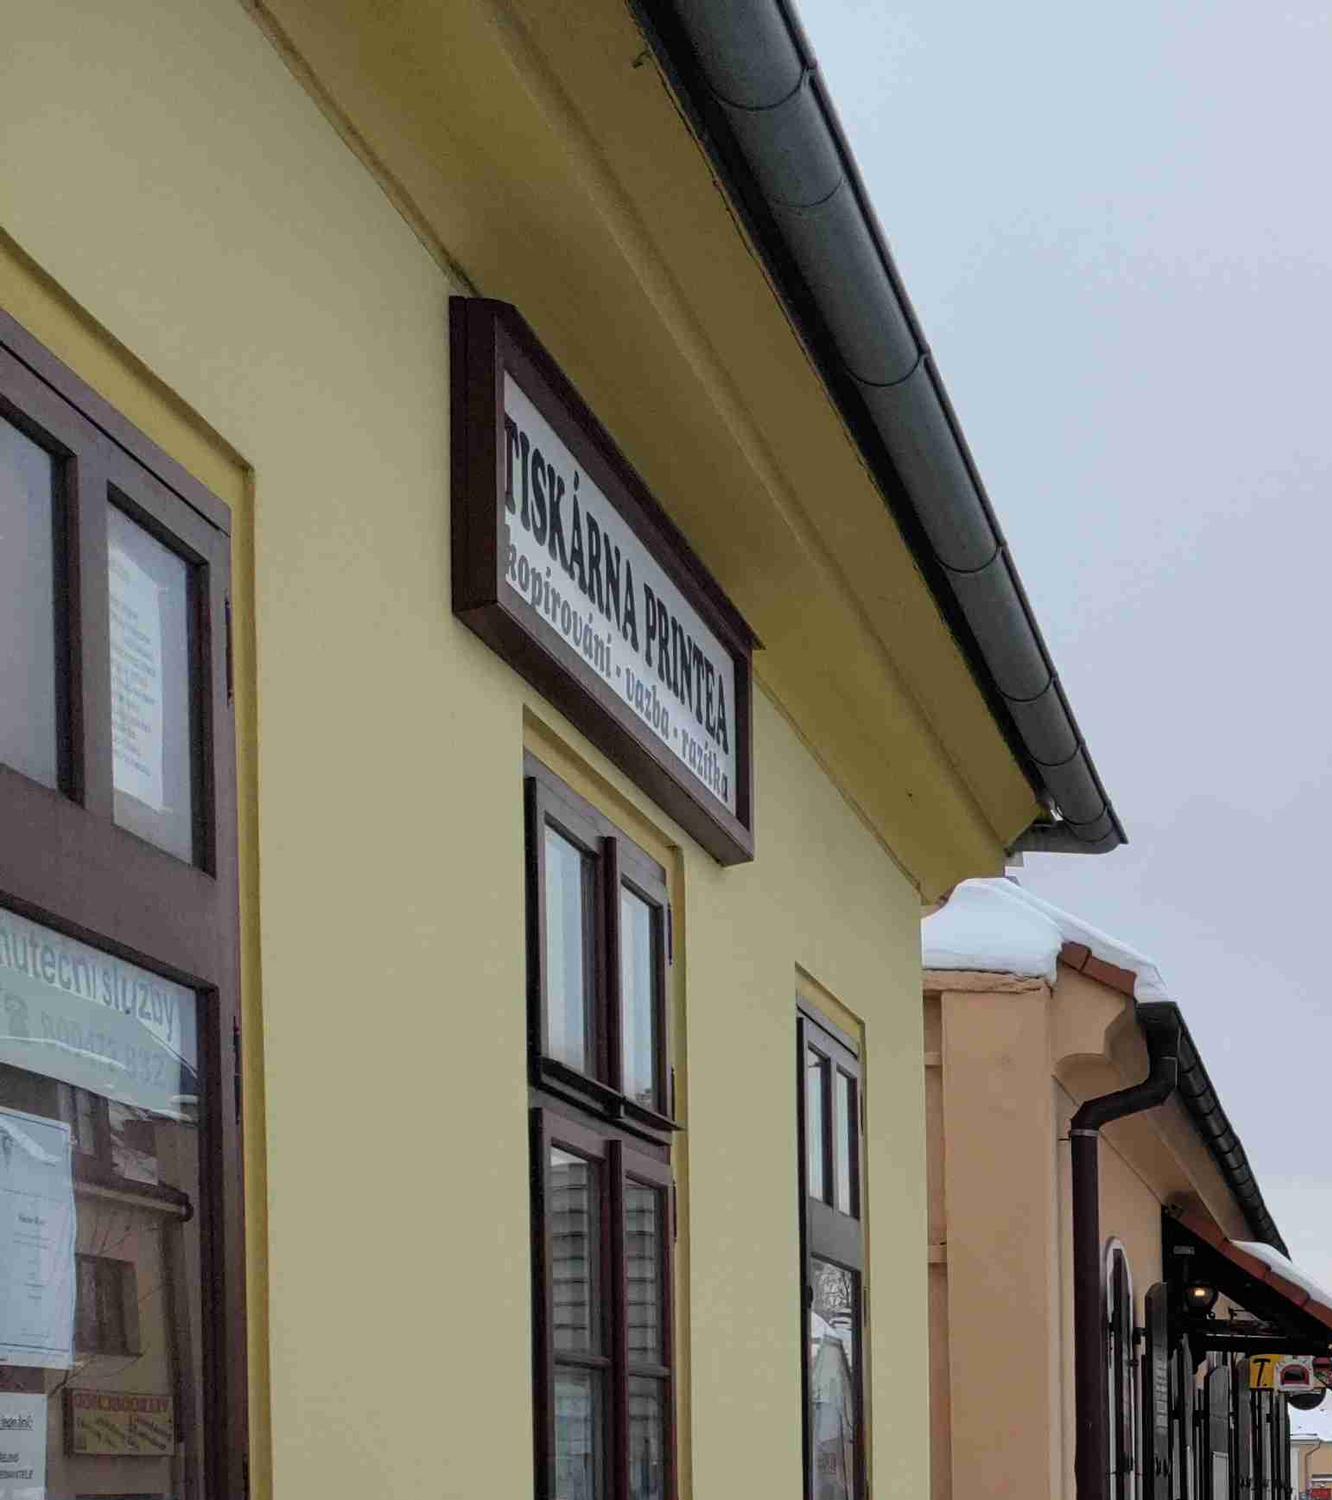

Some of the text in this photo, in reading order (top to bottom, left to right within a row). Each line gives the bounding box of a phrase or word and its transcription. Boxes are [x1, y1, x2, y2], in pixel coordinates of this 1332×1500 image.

[504, 413, 730, 755] TISKÁRNA PRINTEA
[625, 667, 670, 741] vazba
[681, 728, 729, 804] razítka
